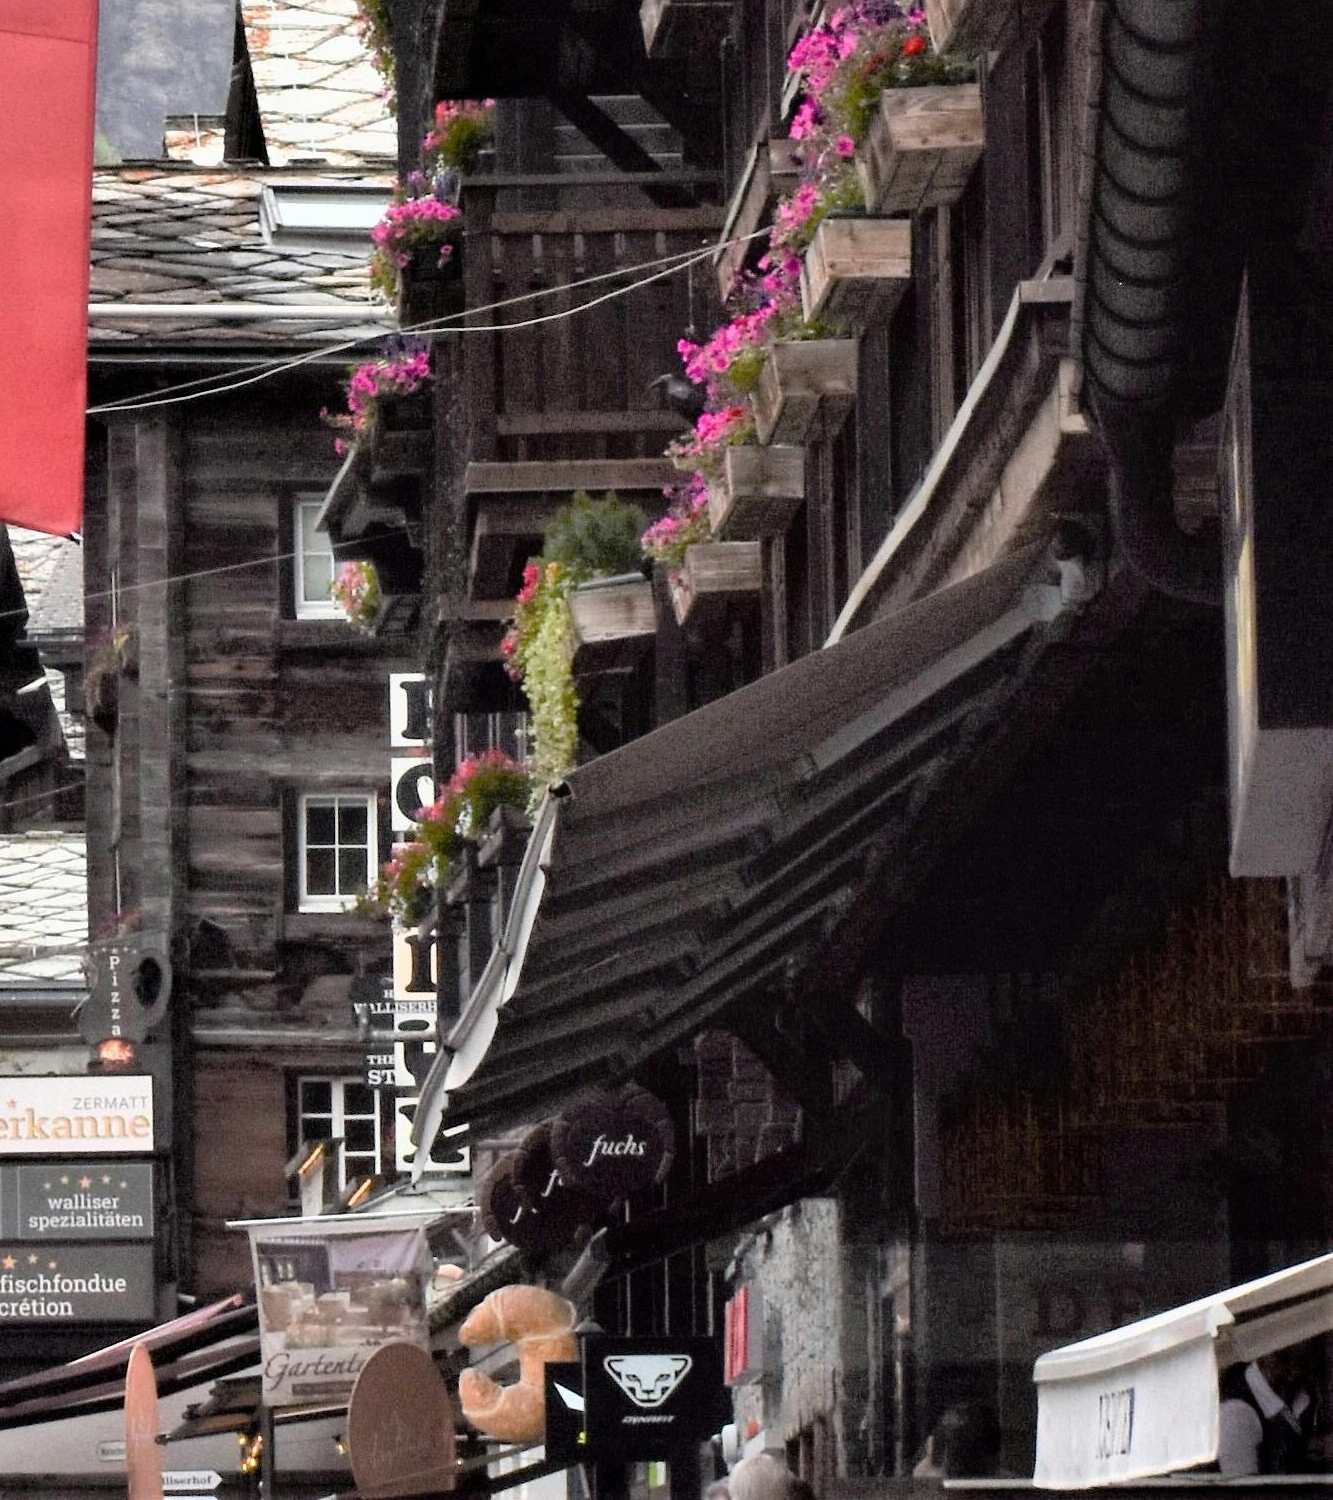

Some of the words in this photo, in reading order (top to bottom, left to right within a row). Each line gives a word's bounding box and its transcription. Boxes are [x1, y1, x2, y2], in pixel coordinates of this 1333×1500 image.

[72, 1095, 149, 1111] ZERMATT
[583, 1133, 646, 1167] fuchs
[47, 1194, 120, 1211] walliser
[28, 1211, 144, 1233] spezialitäten
[0, 1273, 127, 1295] fischfondue
